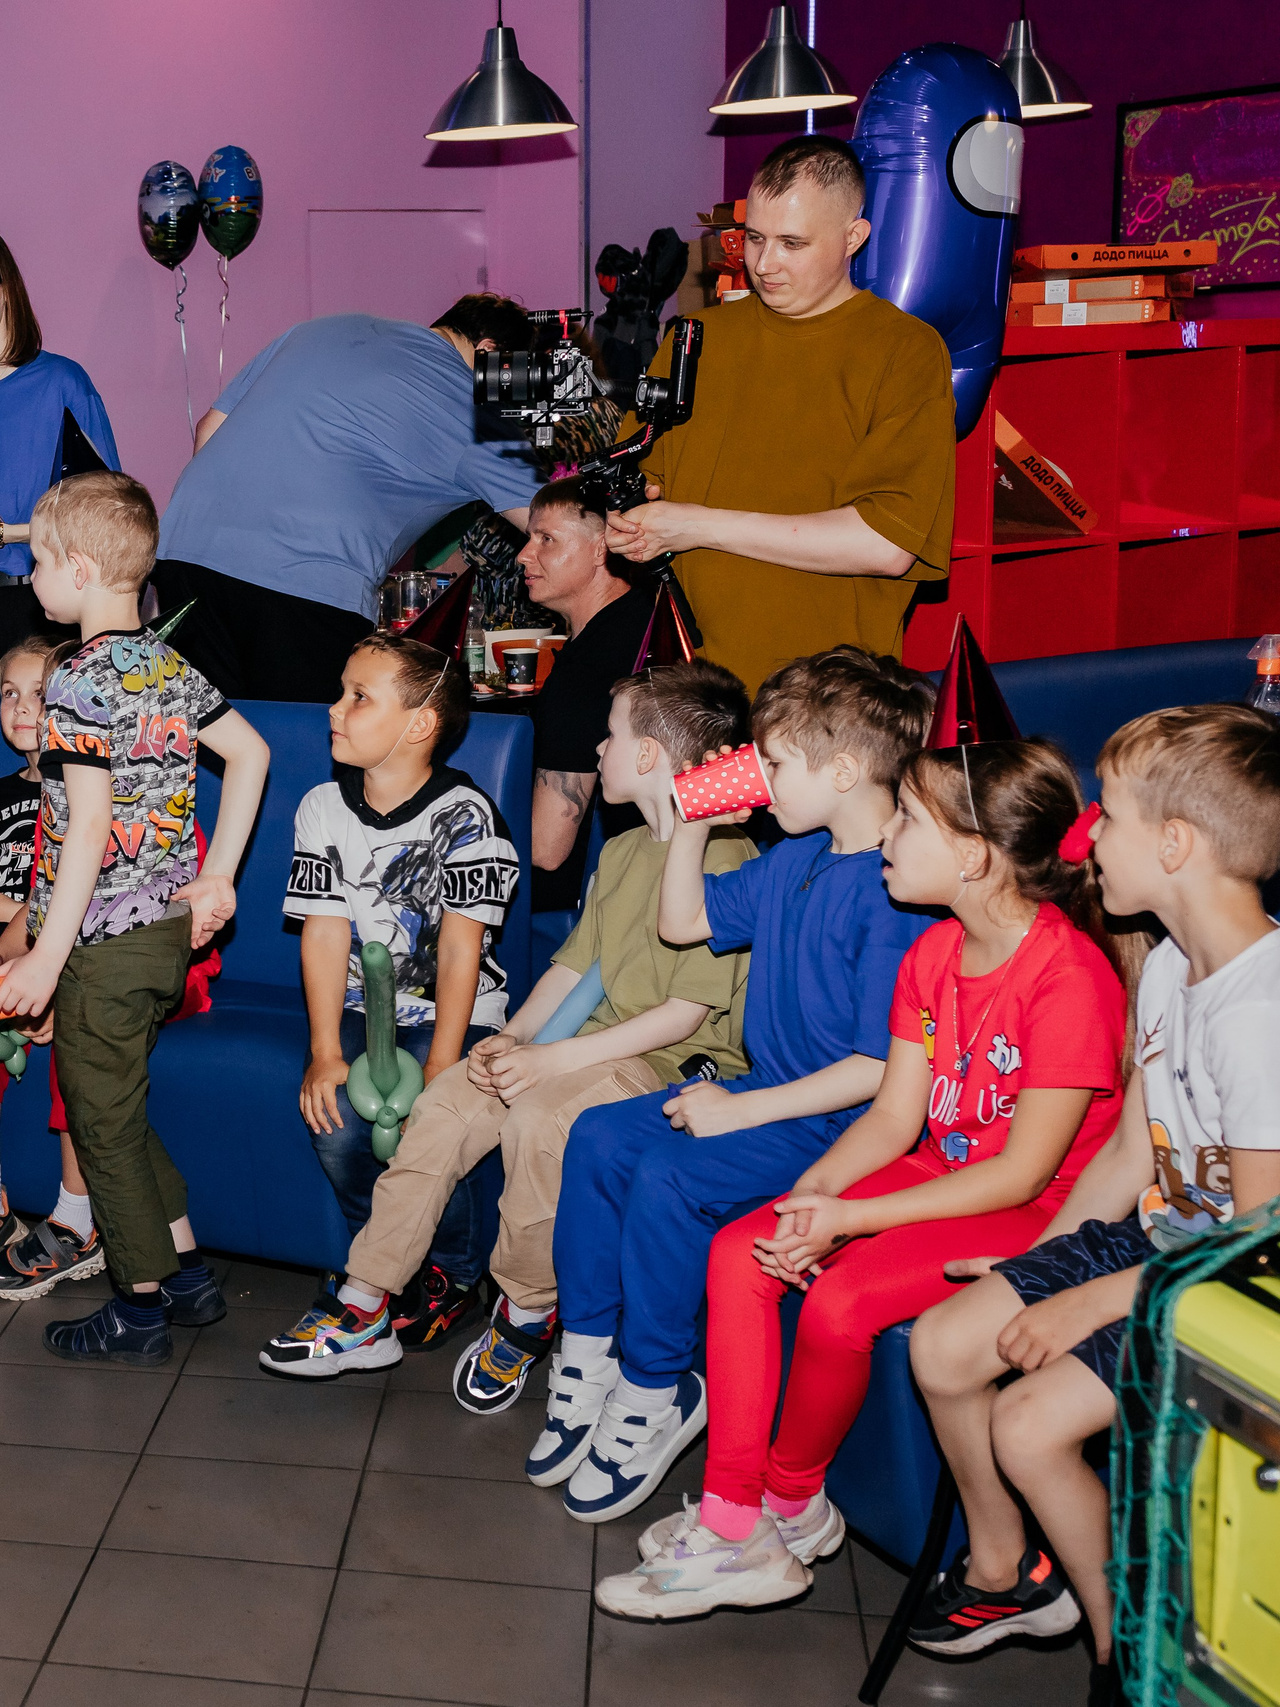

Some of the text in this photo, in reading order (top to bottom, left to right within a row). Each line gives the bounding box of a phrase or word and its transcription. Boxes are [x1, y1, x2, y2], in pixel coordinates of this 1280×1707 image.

[1093, 250, 1168, 261] ДОДО ПИЦЦА
[628, 444, 642, 454] RS2
[1020, 456, 1087, 520] ДОДО ПИЦЦА
